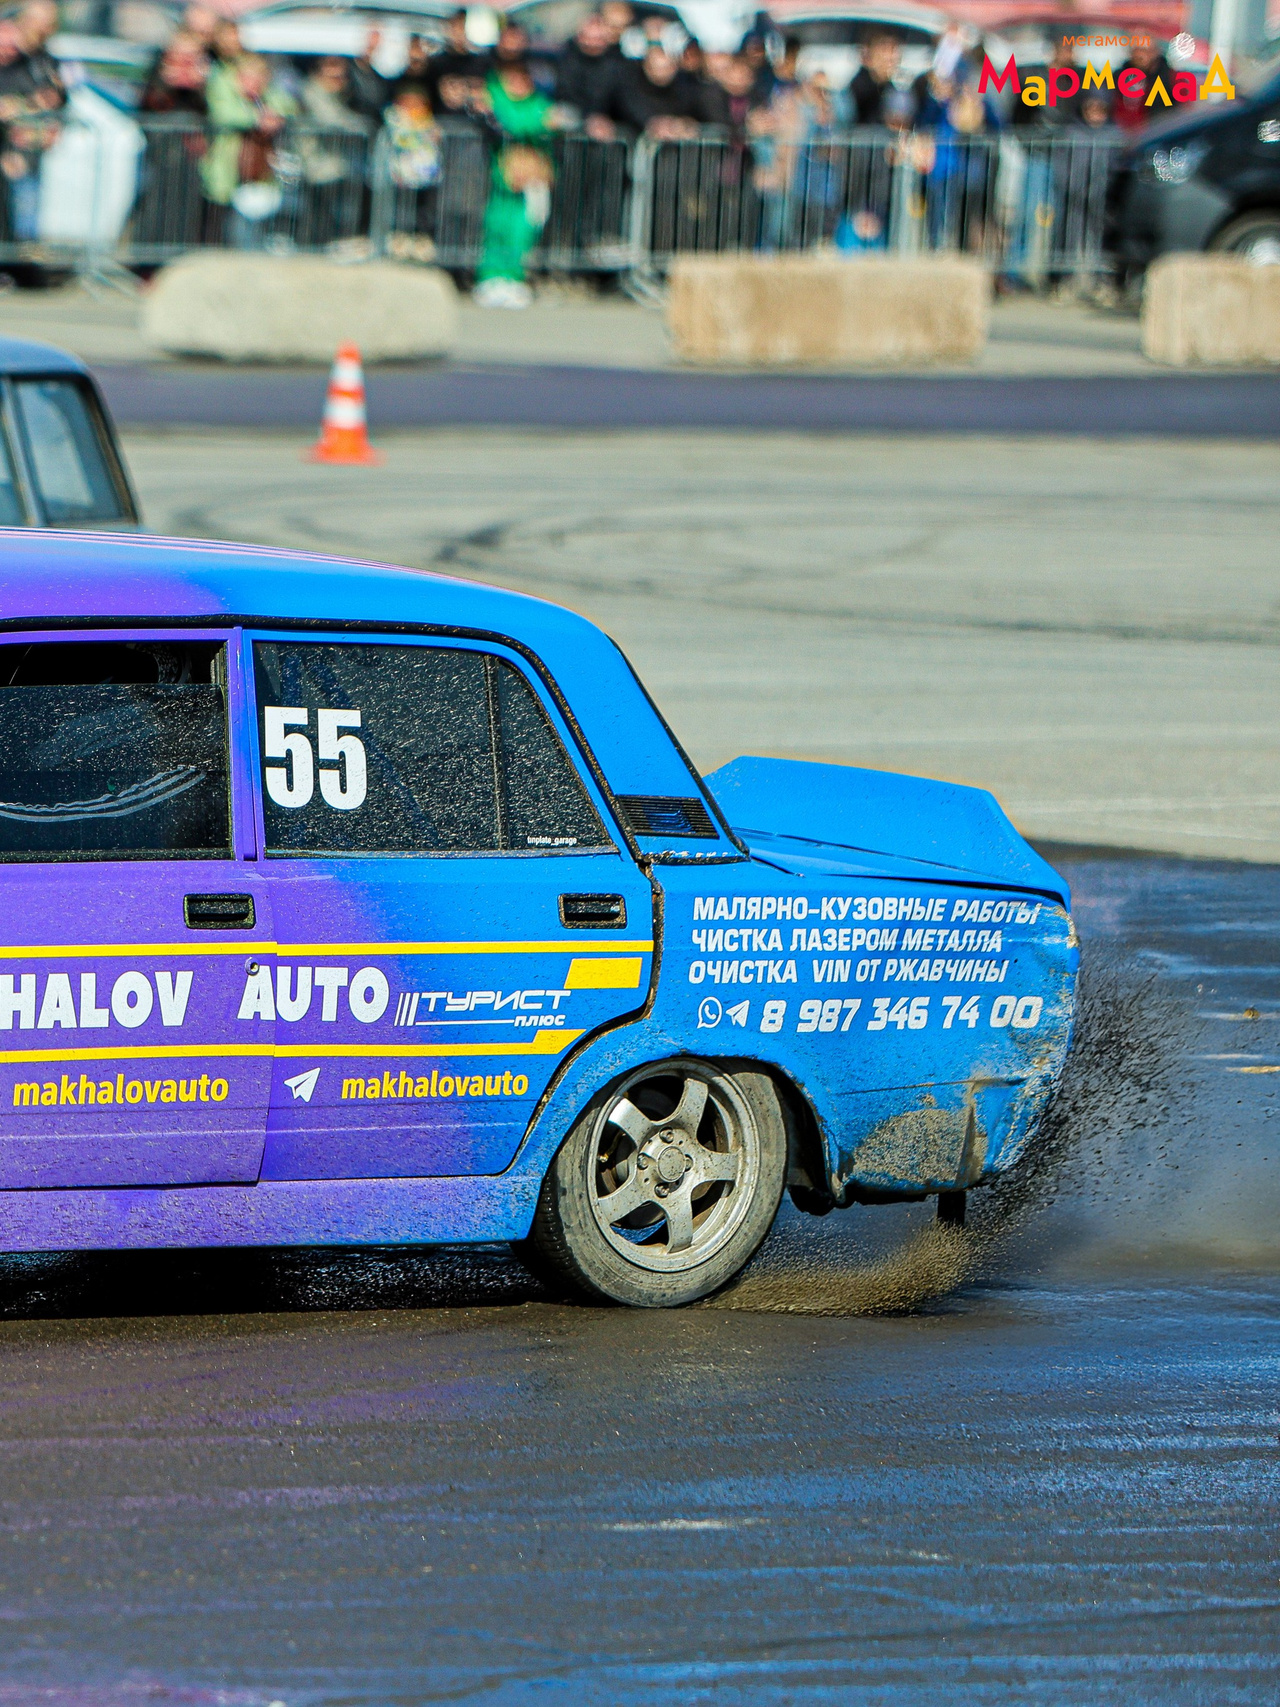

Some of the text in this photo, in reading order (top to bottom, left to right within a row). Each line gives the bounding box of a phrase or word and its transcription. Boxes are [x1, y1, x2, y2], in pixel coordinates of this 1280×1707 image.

[264, 705, 368, 811] 55
[693, 896, 1042, 925] МАЛЯРНО-КУЗОВНЫЕ РАБОТЫ
[691, 928, 1003, 953] ЧИСТКА ЛАЗЕРОМ МЕТАЛЛА
[688, 958, 1010, 985] ОЧИСТКА VIN ОТ РЖАВЧИНЫ
[237, 965, 390, 1024] AUTO
[421, 990, 572, 1013] ТУРИСТ
[760, 995, 1044, 1034] 8 987 346 74 00
[13, 1073, 229, 1107] makhalovauto
[341, 1070, 529, 1100] makhalovauto
